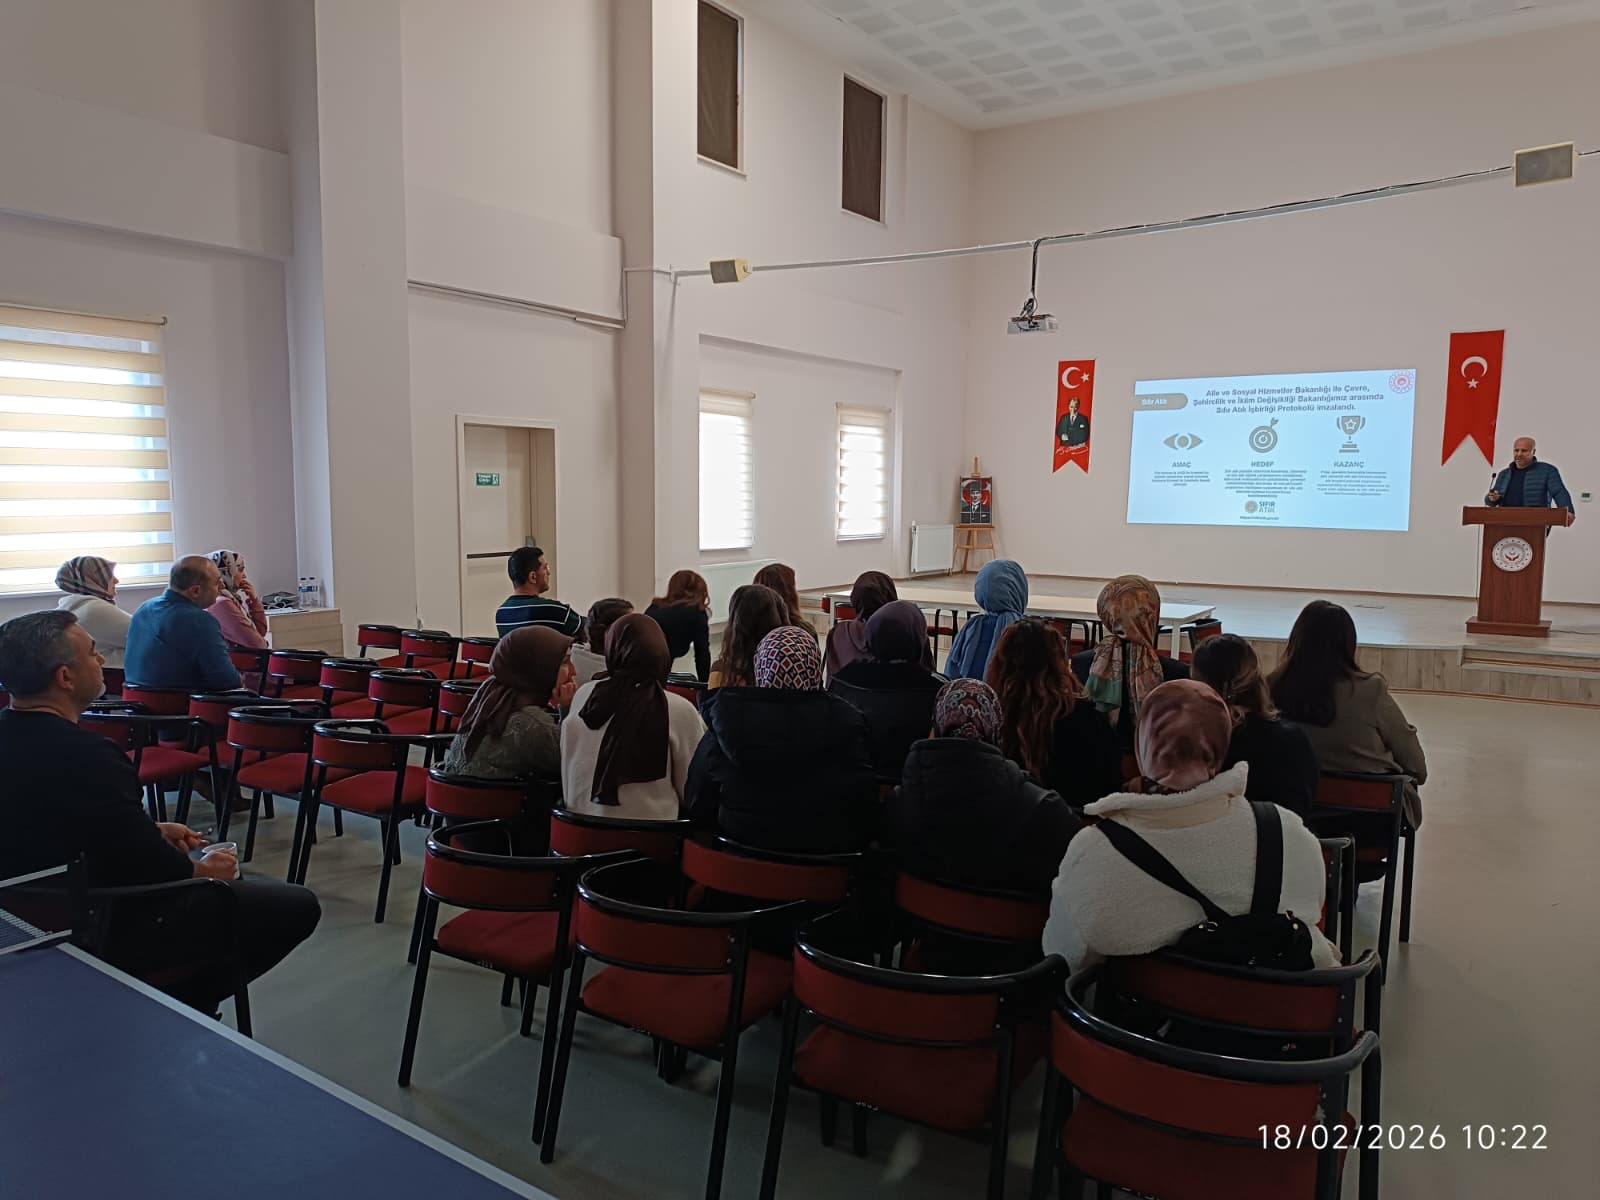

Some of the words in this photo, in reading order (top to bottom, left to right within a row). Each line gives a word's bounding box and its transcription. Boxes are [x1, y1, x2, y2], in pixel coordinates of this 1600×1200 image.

[1232, 388, 1256, 396] Sosyal
[1258, 387, 1293, 395] Hizmetler
[1298, 394, 1347, 402] Bakanlığımız
[1349, 393, 1384, 401] arasında
[1277, 404, 1315, 412] Protokolü
